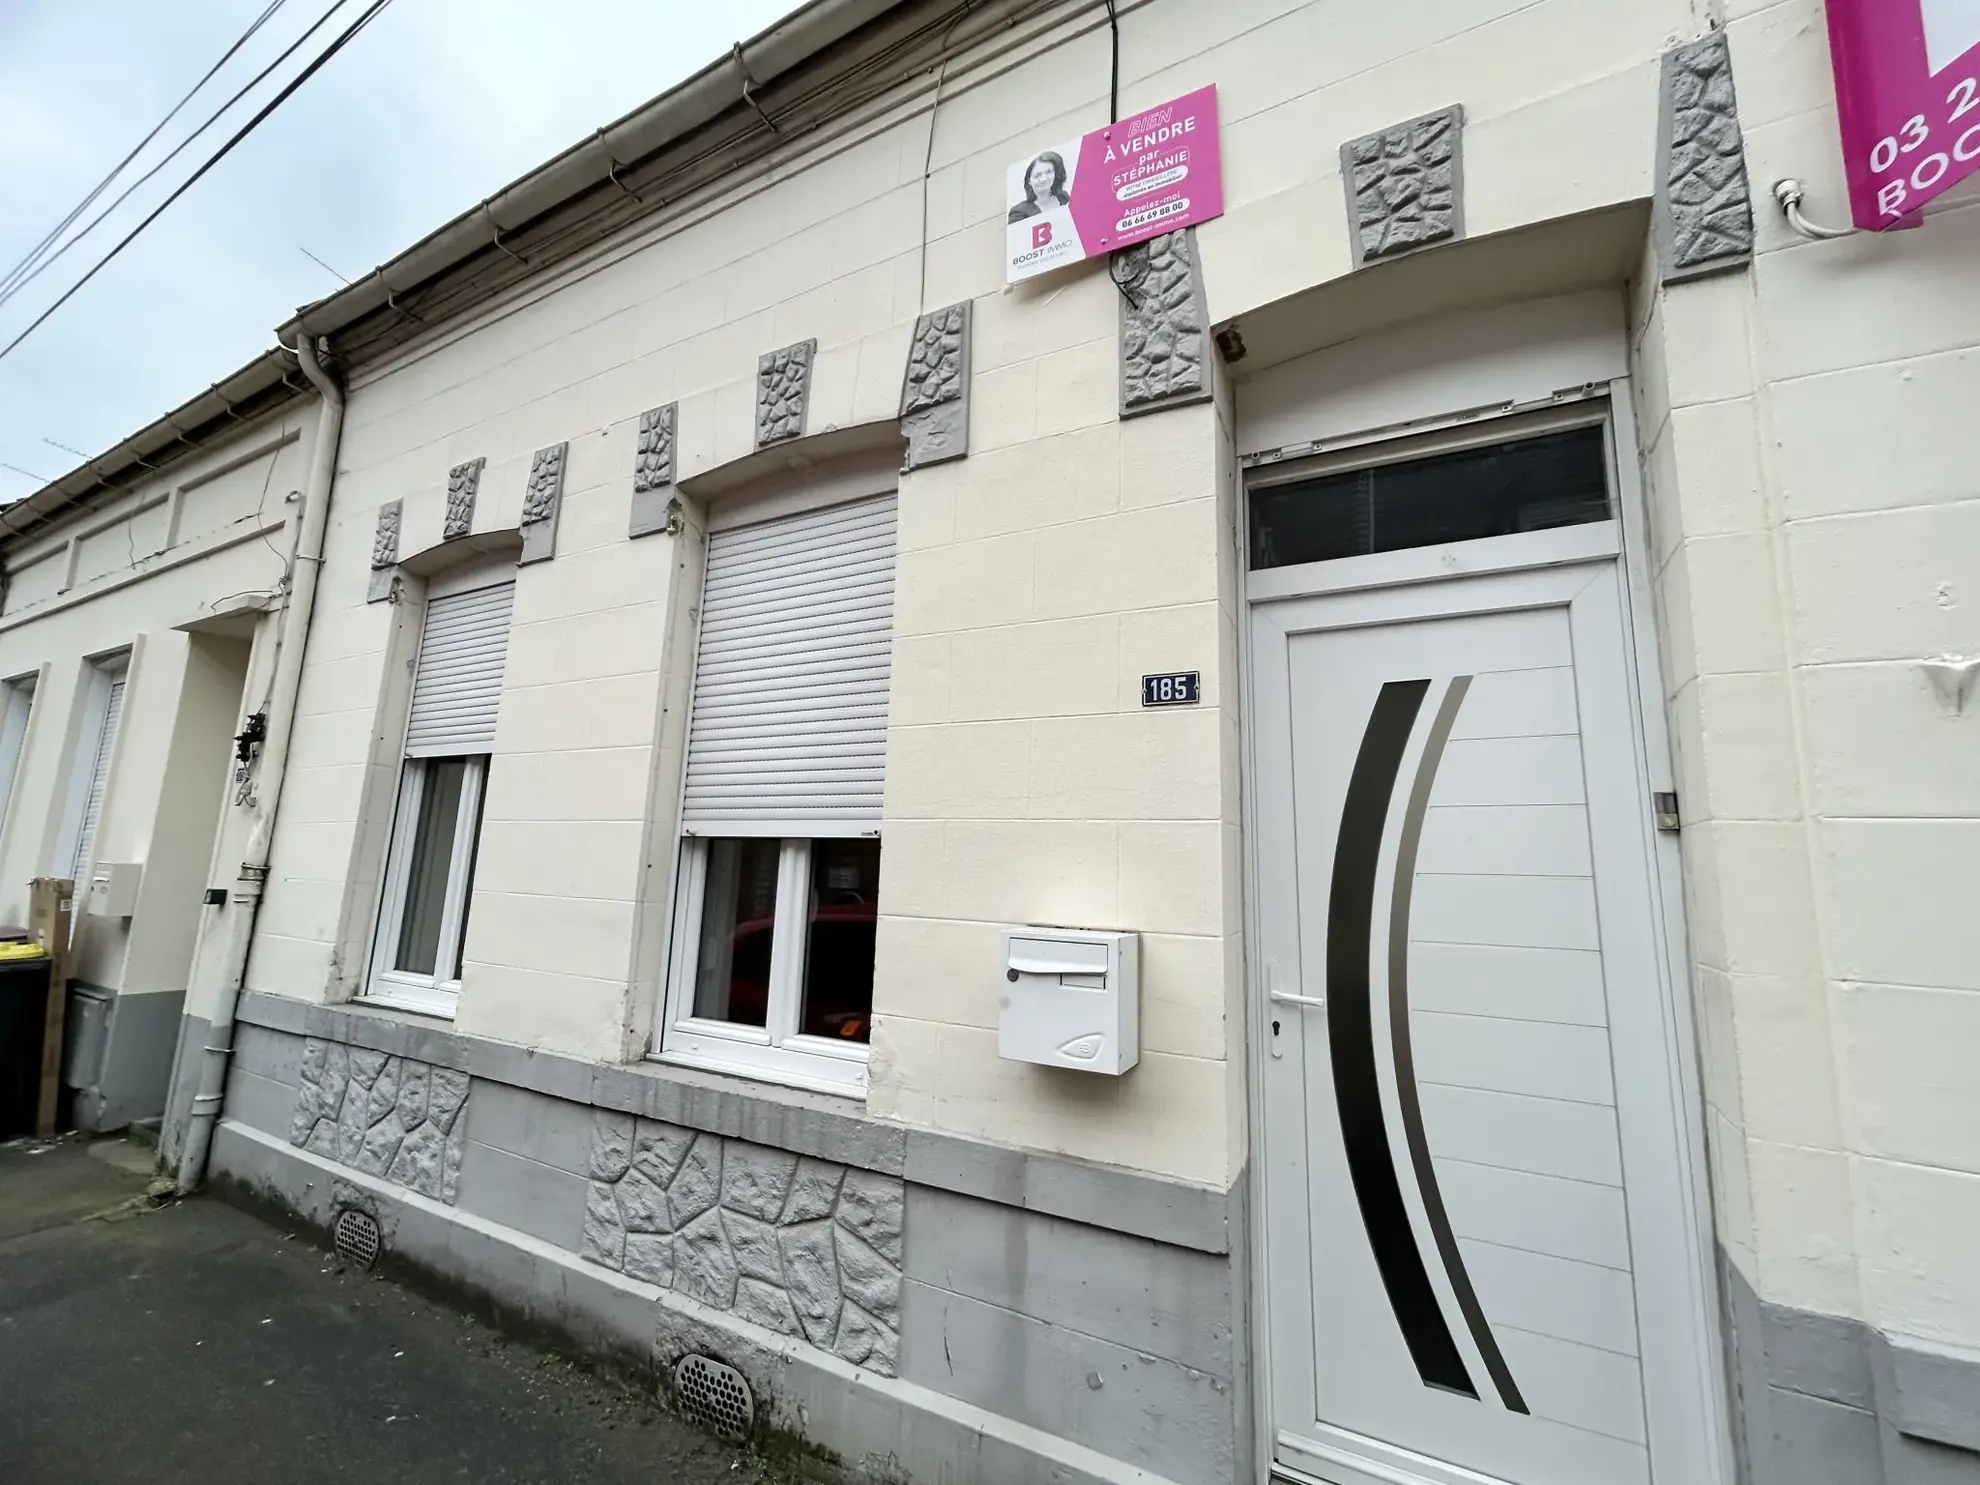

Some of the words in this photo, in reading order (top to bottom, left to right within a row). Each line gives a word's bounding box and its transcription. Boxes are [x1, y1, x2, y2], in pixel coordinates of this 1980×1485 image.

[1128, 107, 1172, 138] BIEN
[1104, 145, 1116, 164] À
[1120, 116, 1196, 156] VENDRE
[1870, 114, 1930, 174] 03
[1113, 150, 1188, 186] STÉPHANIE
[1139, 150, 1160, 165] par
[1122, 219, 1133, 228] 06
[1134, 215, 1145, 224] 66
[1147, 210, 1158, 219] 69
[1160, 206, 1171, 215] 88
[1172, 201, 1183, 211] 00
[1124, 191, 1180, 217] Appelez-moi
[1117, 213, 1190, 240] www.boost-immo.com
[1013, 248, 1044, 265] BOOST
[1047, 239, 1073, 253] IMMO
[1150, 676, 1187, 701] 185
